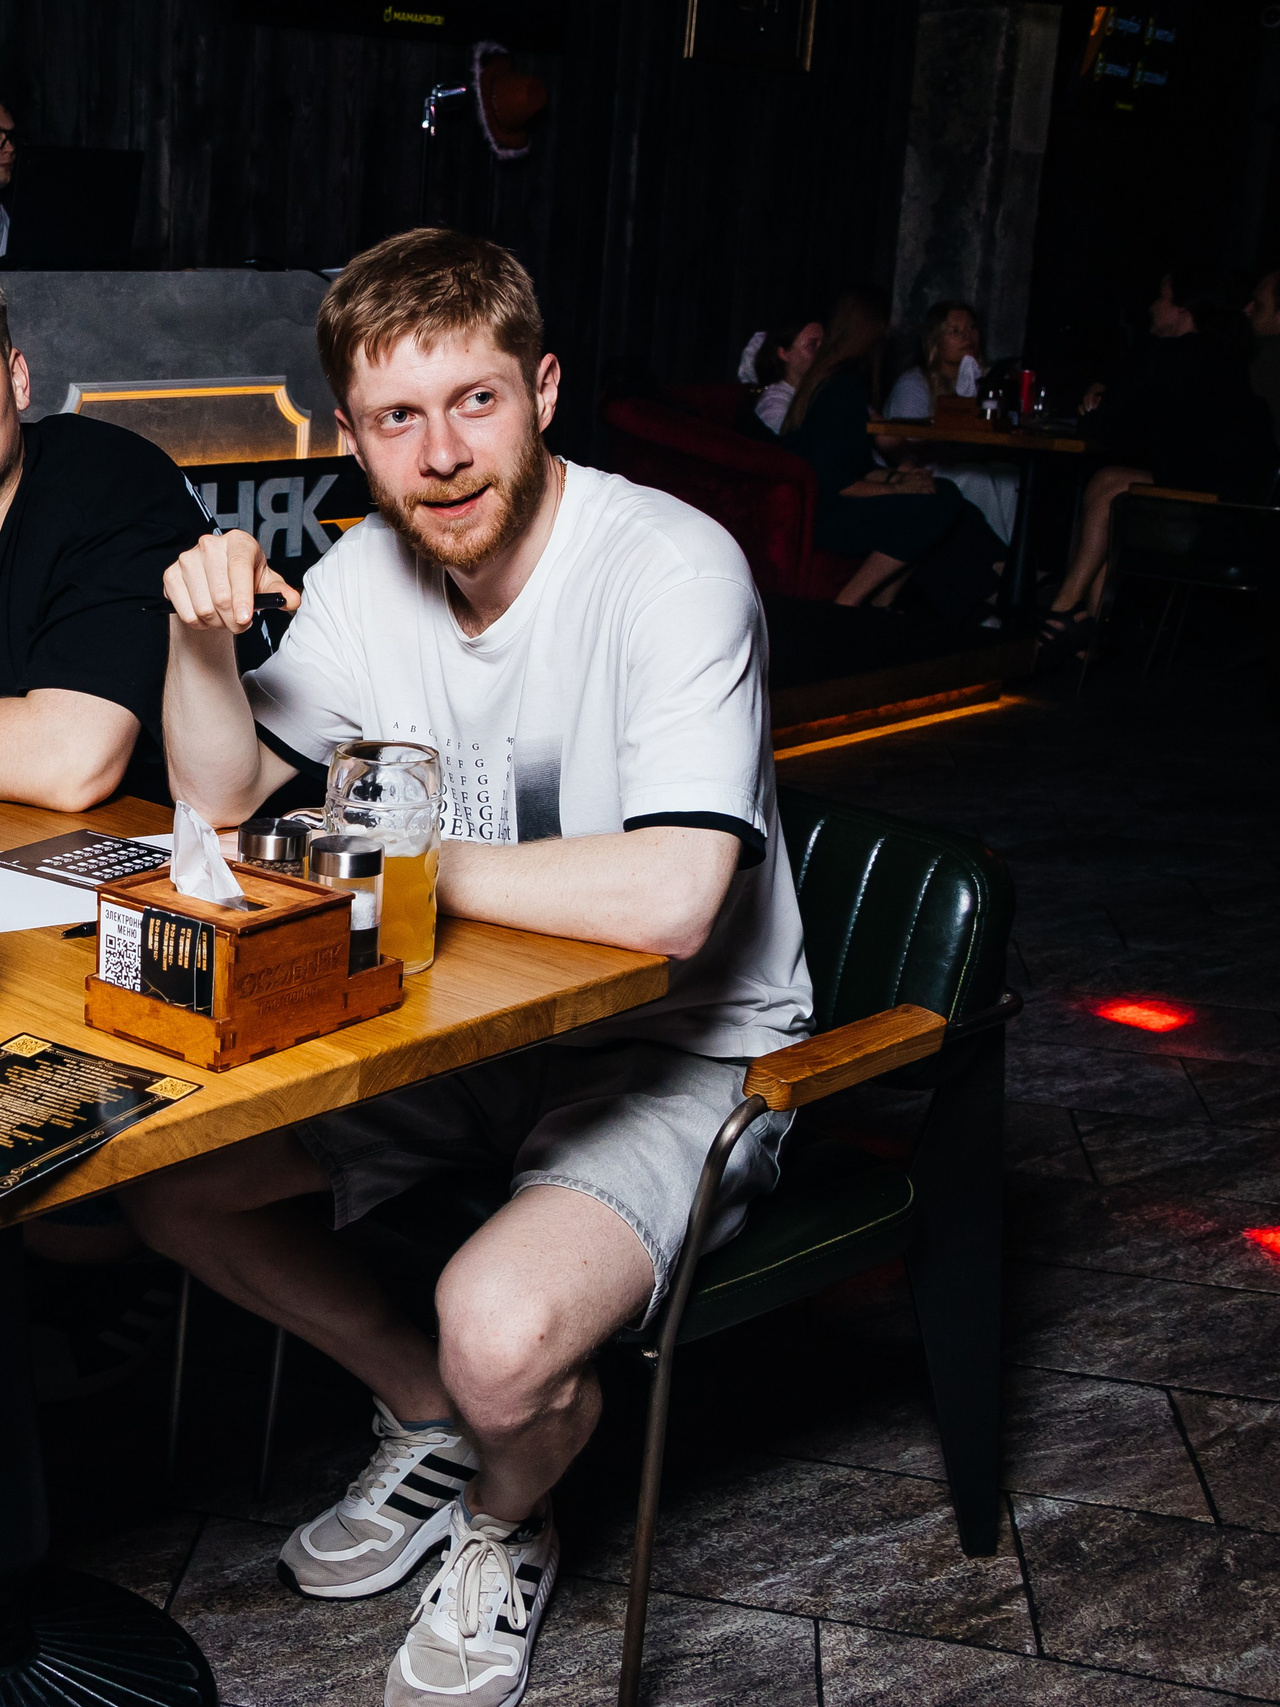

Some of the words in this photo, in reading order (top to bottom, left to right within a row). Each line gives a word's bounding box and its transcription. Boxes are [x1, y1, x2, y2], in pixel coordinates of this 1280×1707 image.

[446, 757, 451, 765] E
[458, 760, 463, 768] F
[475, 759, 483, 767] G
[449, 773, 454, 783] E
[460, 776, 466, 785] F
[478, 775, 487, 785] G
[451, 788, 457, 800] E
[461, 792, 468, 803] F
[477, 791, 489, 803] G
[454, 802, 463, 817] E
[479, 806, 492, 820] G
[450, 818, 463, 836] E
[479, 823, 493, 840] G
[105, 909, 142, 929] ЭЛЕКТРОНН
[117, 924, 138, 939] МЕНЮ
